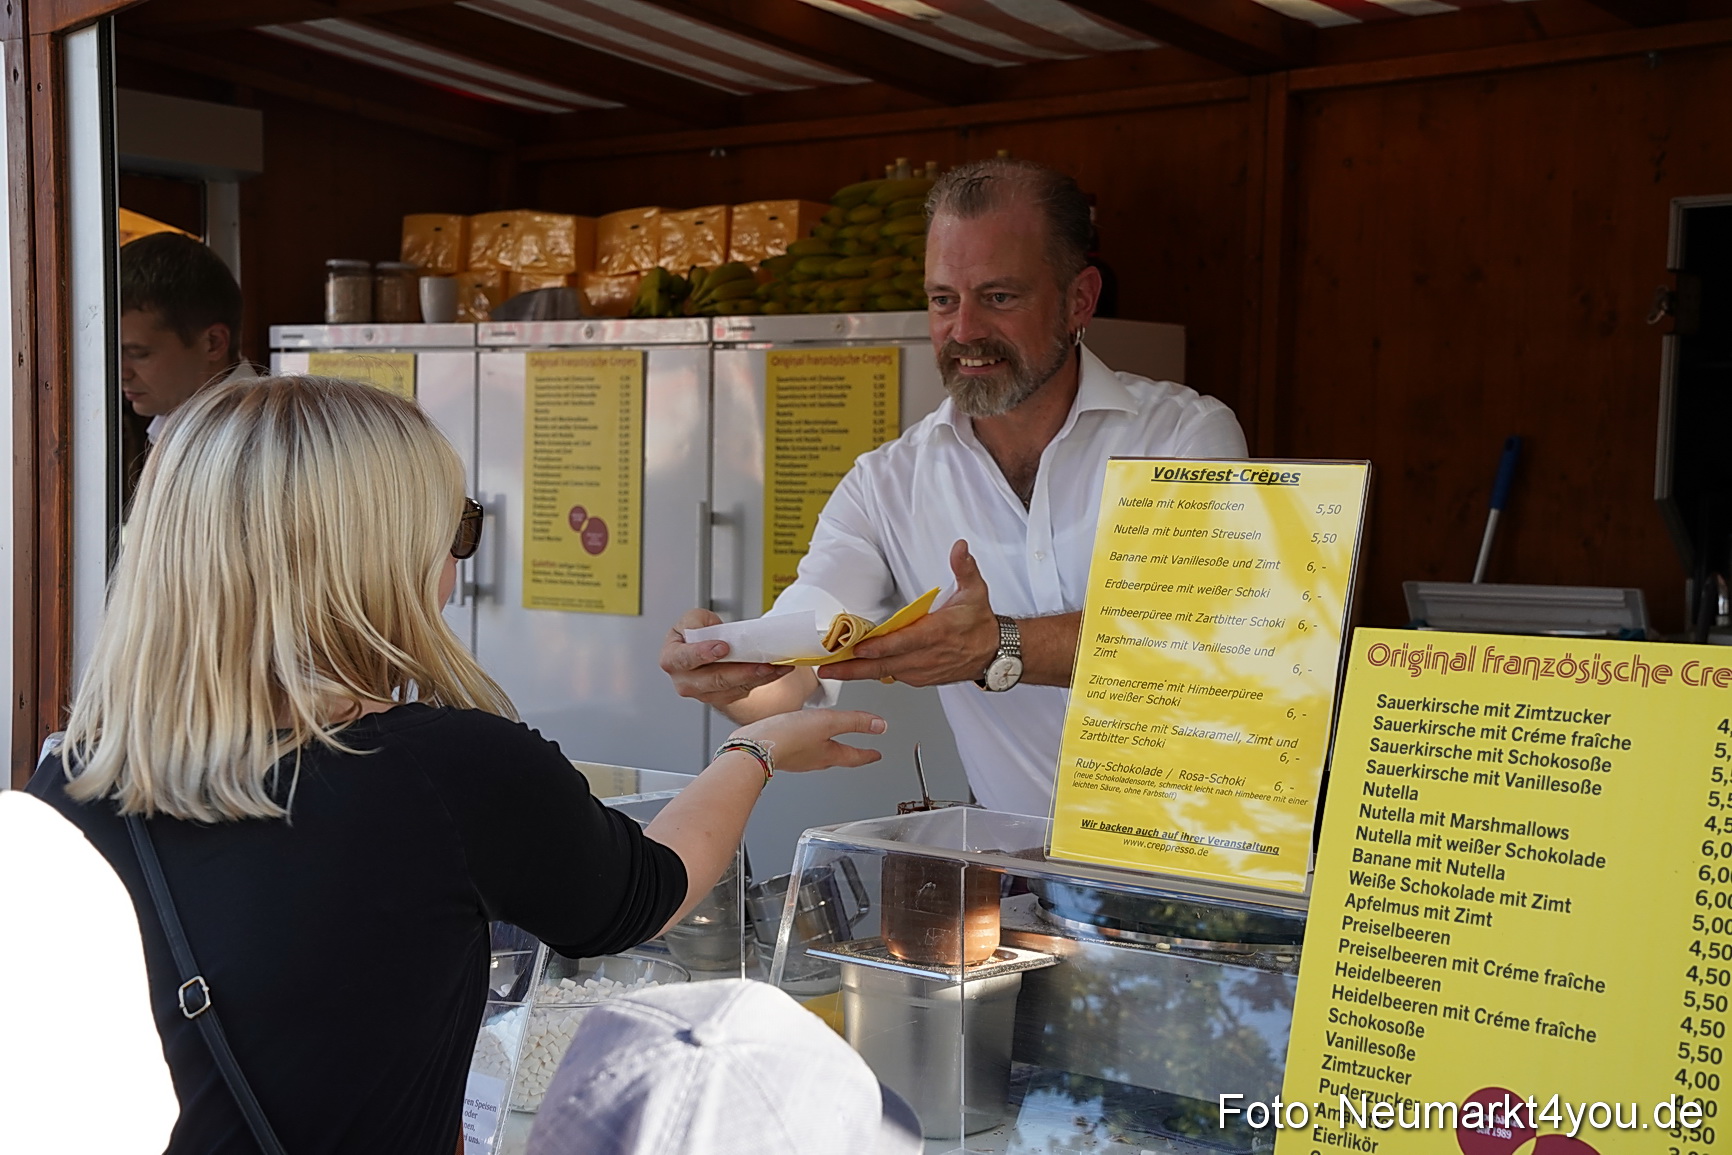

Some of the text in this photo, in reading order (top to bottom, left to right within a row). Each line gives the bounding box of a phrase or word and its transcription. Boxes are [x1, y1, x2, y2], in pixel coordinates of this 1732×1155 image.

[1118, 497, 1342, 516] Nutella mit Kokosflocken 5,50
[1114, 524, 1337, 545] Nutella mit bunten Streuseln 5,50
[1109, 551, 1148, 563] Banane
[1150, 554, 1169, 564] mit
[1172, 555, 1229, 567] Vanillesoße
[1232, 558, 1253, 569] und
[1255, 559, 1281, 570] Zimt
[1105, 579, 1174, 593] Erdbeerpüree
[1176, 584, 1195, 594] mit
[1197, 585, 1233, 596] weißer
[1235, 587, 1271, 598] Schoki
[1100, 606, 1172, 621] Himbeerpüree
[1175, 612, 1193, 622] mit
[1195, 612, 1247, 625] Zartbitter
[1249, 616, 1286, 628] Schoki
[1093, 647, 1118, 658] Zimt
[1096, 633, 1276, 657] Marshmallows mit Vanillesoße und
[1367, 642, 1477, 678] Original
[1482, 646, 1673, 688] französische
[1087, 689, 1182, 707] und weißer Schoki
[1089, 675, 1263, 700] Zitronencreme mit Himbeerpüree
[1377, 694, 1479, 715] Sauerkirsche
[1484, 702, 1511, 718] mit
[1514, 704, 1611, 725] Zimtzucker
[1080, 730, 1166, 748] Zartbitter Schoki
[1082, 716, 1299, 748] Sauerkirsche mit Salzkaramell, Zimt und
[1373, 715, 1476, 738] Sauerkirsche
[1480, 725, 1507, 740] mit
[1511, 726, 1566, 745] Créme
[1571, 731, 1631, 750] fraîche
[1076, 759, 1163, 777] Ruby-Schokolade
[1178, 770, 1246, 787] Rosa-Schoki
[1369, 737, 1732, 786] Sauerkirsche mit Schokosoße 5,
[1072, 780, 1177, 801] leichten Säure, ohne Farbstoff)
[1074, 770, 1094, 780] (neue
[1095, 773, 1156, 788] Schokoladensorte,
[1158, 781, 1193, 792] schmeckt
[1193, 784, 1214, 794] leicht
[1235, 790, 1271, 801] Himbeere
[1273, 795, 1287, 803] mit
[1288, 797, 1309, 806] einer
[1363, 781, 1418, 801] Nutella
[1366, 759, 1469, 783] Sauerkirsche
[1473, 770, 1500, 786] mit
[1505, 772, 1602, 796] Vanillesoße
[1080, 819, 1280, 855] Wir backen auch auf ihrer Veranstaltung
[1359, 803, 1415, 823] Nutella
[1419, 811, 1446, 827] mit
[1450, 813, 1569, 841] Marshmallows
[1123, 839, 1209, 857] www.creppresso.de
[1356, 825, 1411, 846] Nutella
[1416, 833, 1442, 850] mit
[1446, 838, 1501, 856] weißer
[1505, 842, 1606, 869] Schokolade
[1352, 848, 1411, 869] Banane
[1415, 857, 1442, 873] mit
[1446, 859, 1505, 881] Nutella
[1349, 870, 1732, 936] Weiße Schokolade mit Zimt 5,00
[1344, 893, 1732, 961] Apfelmus mit Zimt 4,50
[1342, 915, 1731, 987] Preiselbeeren 4,50
[1338, 938, 1728, 1013] Preiselbeeren mit Créme fraîche 5,50
[1335, 961, 1725, 1039] Heidelbeeren 4,50
[1332, 984, 1722, 1065] Heidelbeeren mit Créme fraîche 5,50
[1326, 1030, 1416, 1061] Vanillesoße
[1328, 1007, 1720, 1091] Schokosoße 4,00
[1321, 1054, 1412, 1085] Zimtzucker
[464, 1110, 478, 1119] oder
[475, 1099, 496, 1112] Speisen
[1311, 1125, 1378, 1155] Eierlikör
[1492, 1127, 1512, 1140] 1989
